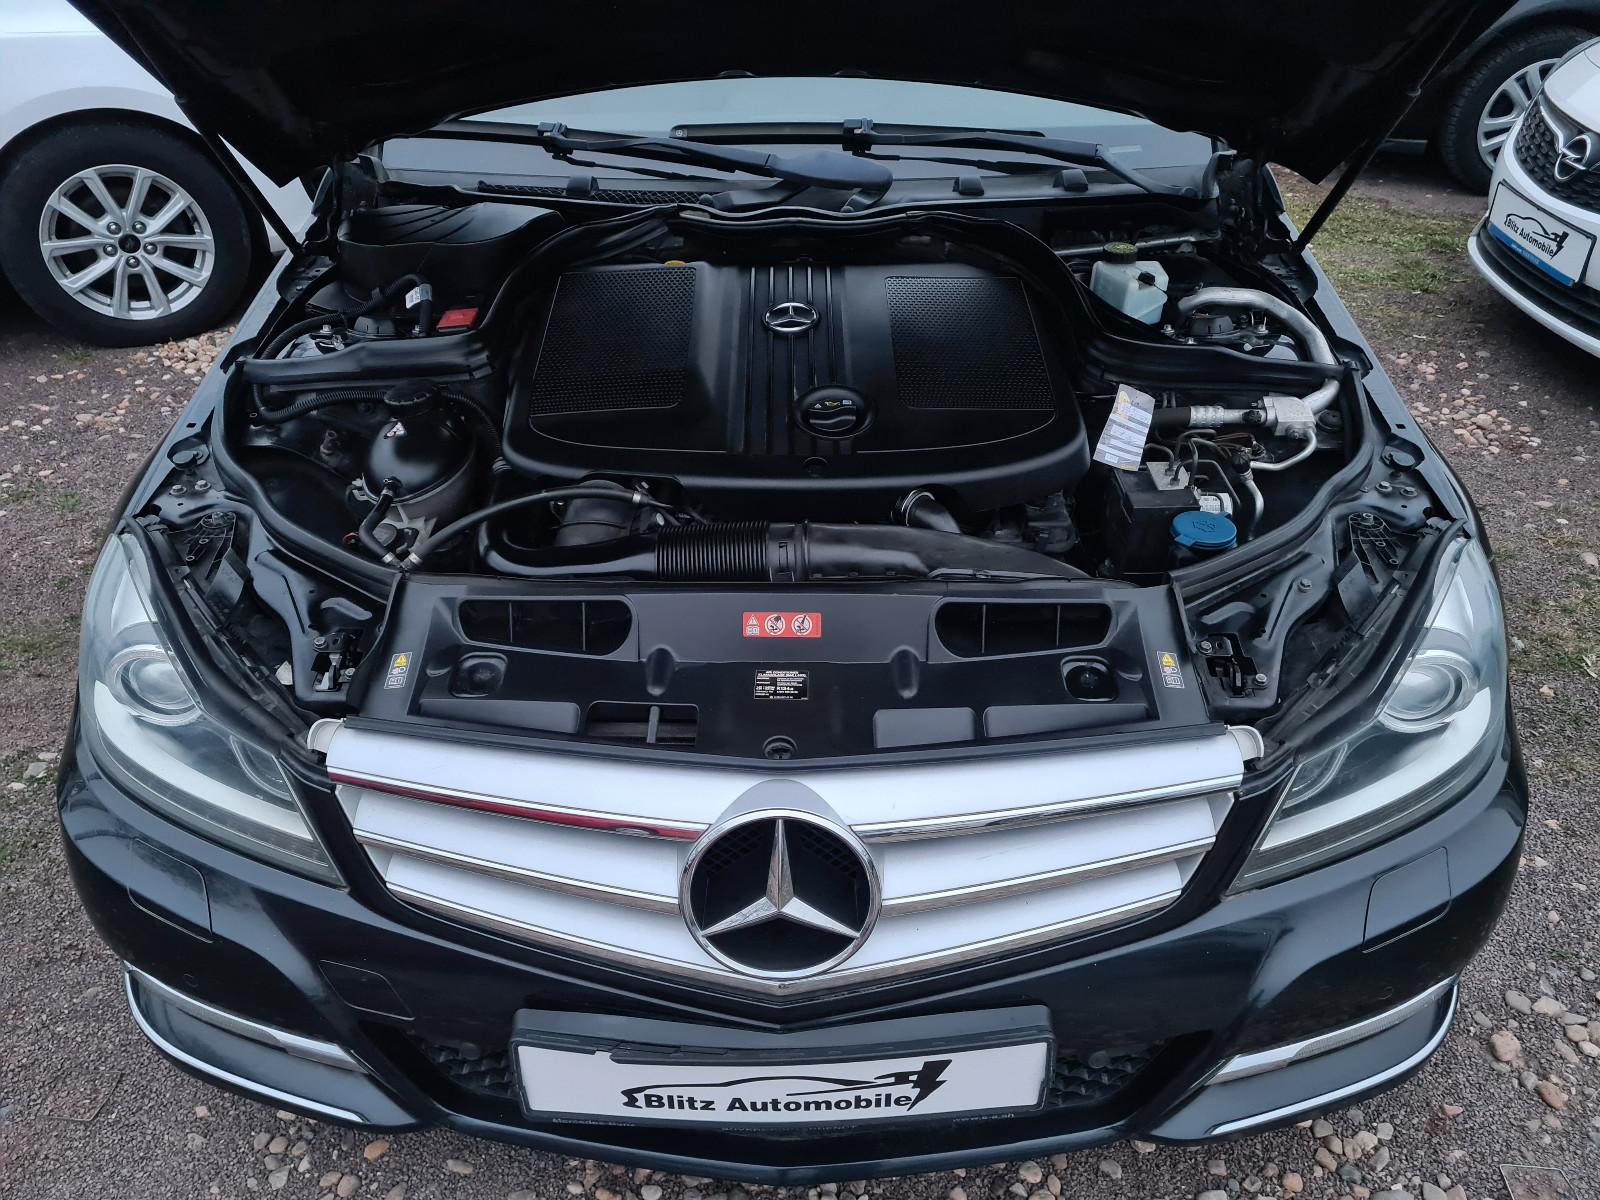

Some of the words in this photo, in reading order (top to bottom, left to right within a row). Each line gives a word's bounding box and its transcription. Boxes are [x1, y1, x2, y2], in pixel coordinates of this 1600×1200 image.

[1507, 218, 1519, 233] Blitz
[1519, 228, 1554, 256] Automobile
[644, 1093, 716, 1111] Blitz
[726, 1093, 912, 1112] Automobile
